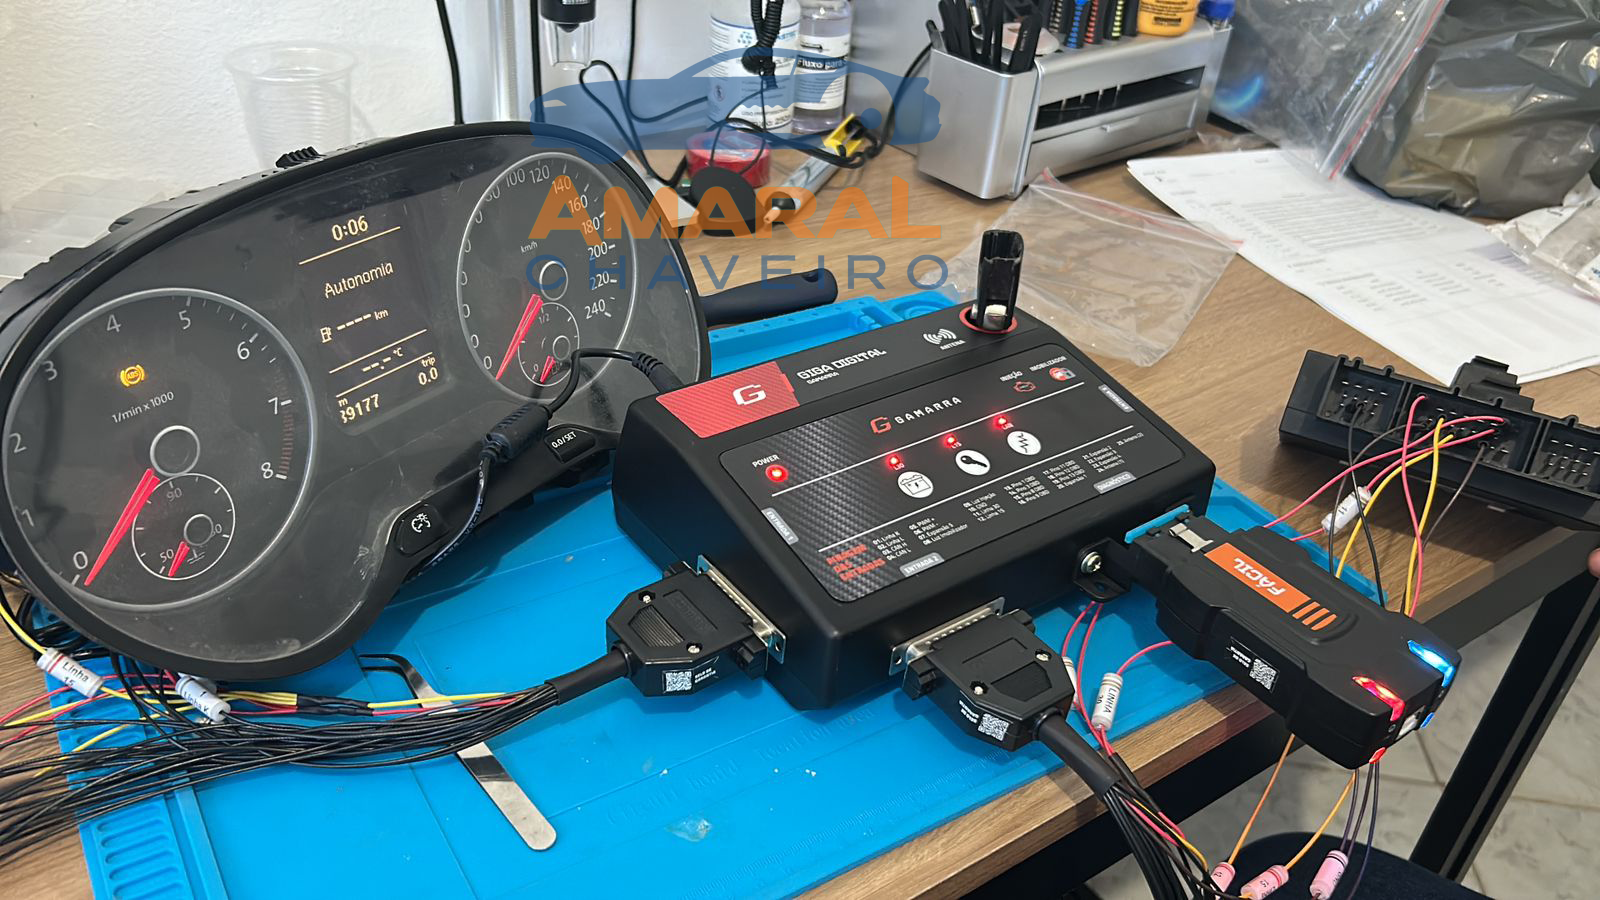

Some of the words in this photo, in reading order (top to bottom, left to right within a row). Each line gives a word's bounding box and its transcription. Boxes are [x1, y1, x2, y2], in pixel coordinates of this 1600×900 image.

[506, 168, 526, 188] 100
[529, 164, 550, 184] 120
[552, 175, 571, 194] 140
[568, 194, 588, 213] 160
[331, 216, 369, 241] 0:06
[581, 216, 600, 235] 180
[520, 241, 538, 254] km/h
[587, 241, 608, 261] 200
[324, 262, 394, 298] Autonomia
[590, 271, 610, 291] 220
[374, 309, 389, 321] km
[584, 299, 606, 320] 240
[106, 314, 121, 333] 4
[179, 311, 191, 329] 5
[237, 342, 250, 360] 6
[41, 361, 58, 381] 3
[421, 357, 436, 368] trip
[797, 364, 833, 381] GIGA
[831, 348, 887, 369] DIGITAL
[127, 371, 139, 379] ABS
[418, 367, 439, 386] 0.0
[338, 397, 348, 407] m
[732, 384, 767, 405] G
[112, 406, 142, 424] 1/min
[150, 391, 174, 407] 1000
[268, 397, 278, 415] 7
[870, 416, 892, 434] G
[894, 396, 962, 425] GAMARRA
[9, 432, 26, 454] 2
[260, 462, 274, 478] 8
[752, 454, 780, 468] POWER
[167, 487, 182, 501] 90
[21, 508, 34, 527] 1
[766, 511, 789, 538] ENTRADA
[73, 550, 88, 570] 0
[160, 549, 174, 563] 50
[904, 558, 933, 573] ENTRADA
[1233, 557, 1286, 597] FÁCIL
[62, 661, 89, 683] Linha
[1103, 687, 1118, 714] LINHA
